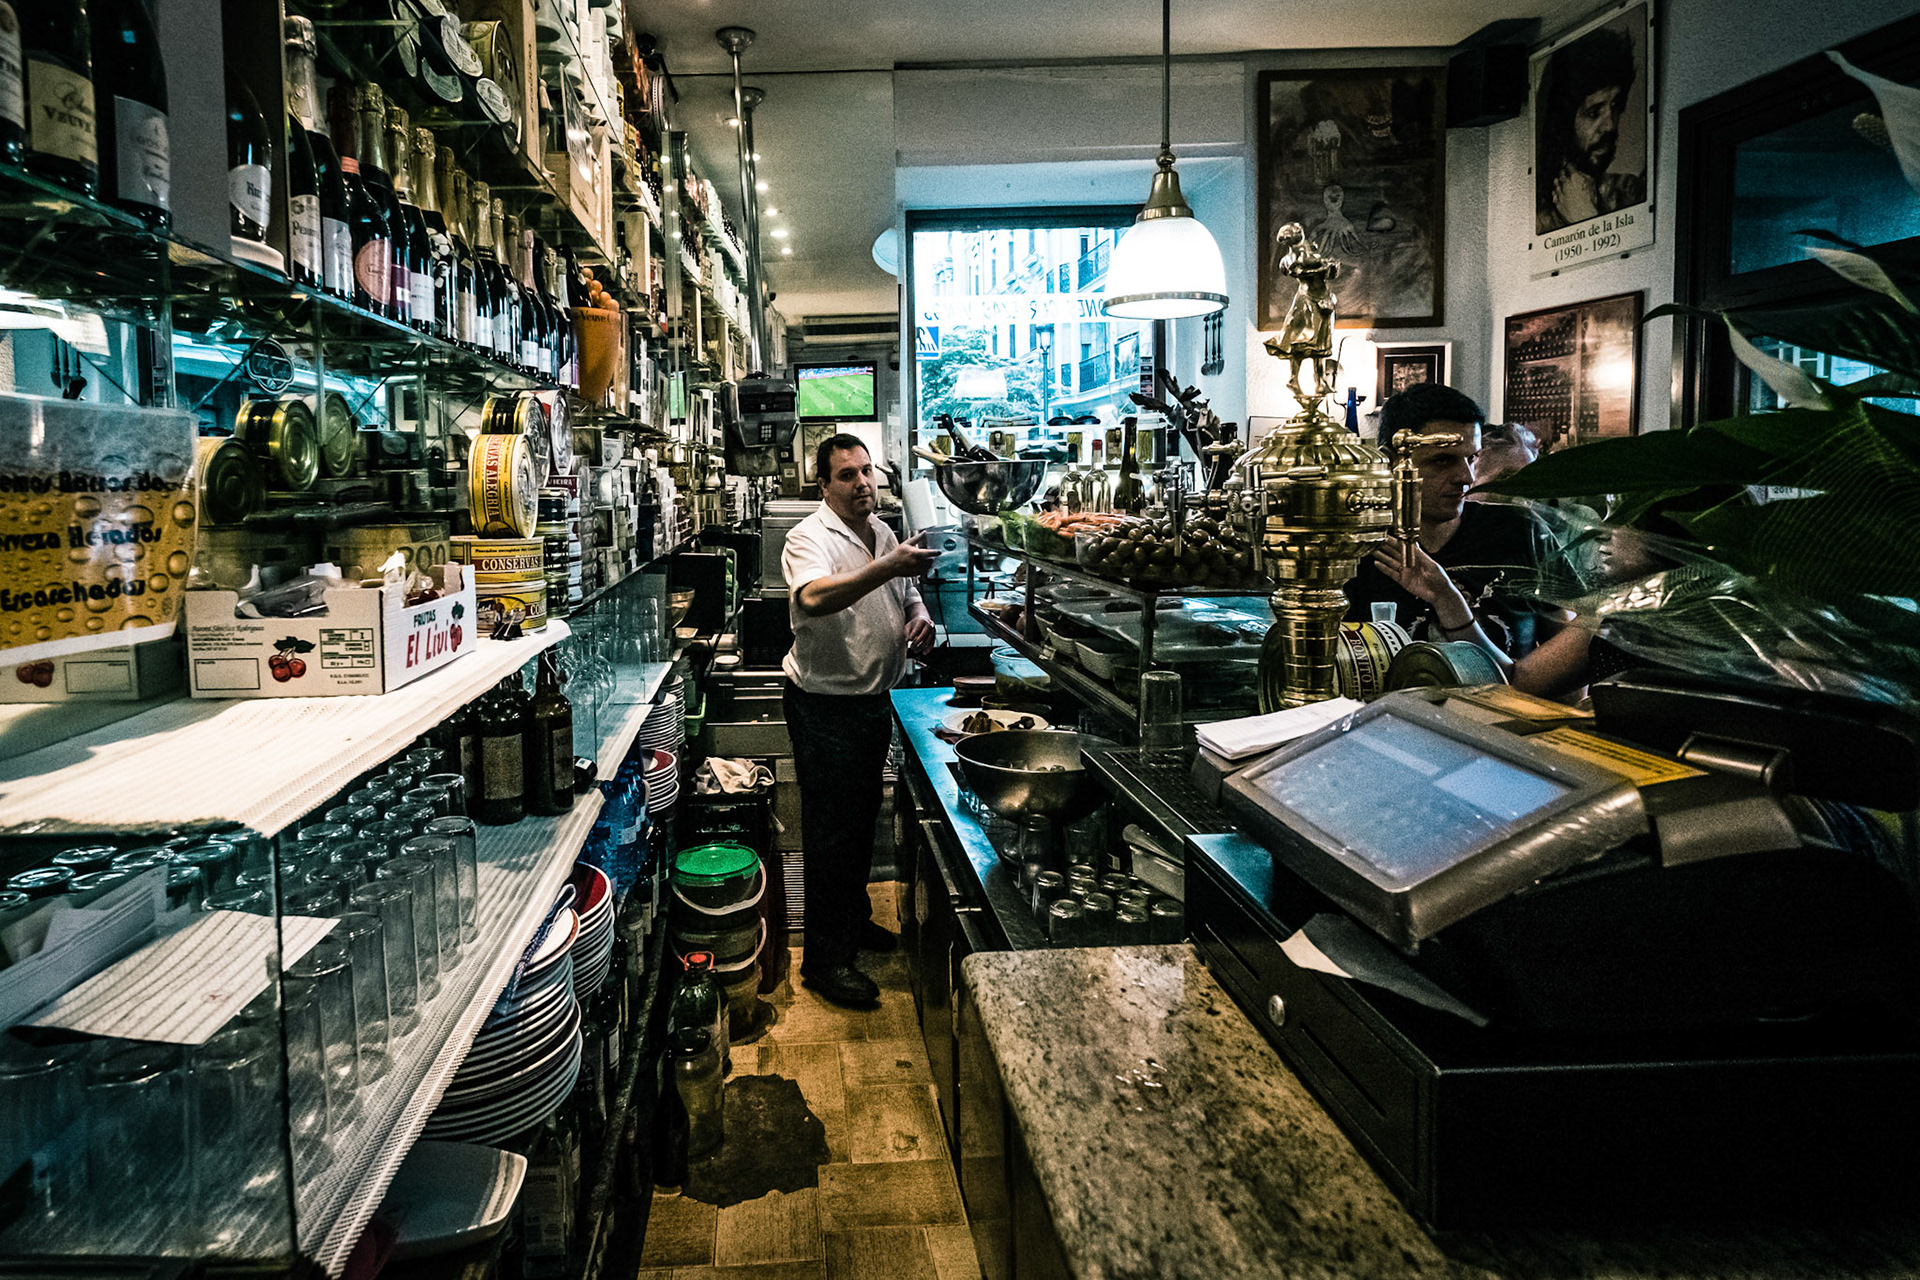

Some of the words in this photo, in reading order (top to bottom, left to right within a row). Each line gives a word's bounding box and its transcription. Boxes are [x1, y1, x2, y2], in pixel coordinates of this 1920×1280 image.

[1544, 228, 1586, 250] Camarón
[1588, 223, 1600, 237] de
[1603, 219, 1613, 232] la
[1615, 213, 1634, 229] Isla
[1555, 245, 1582, 263] (1950
[1593, 233, 1621, 252] 1992)
[486, 469, 500, 516] ALEGRIA
[482, 556, 539, 572] CONSERVAS
[0, 577, 146, 612] Escarchados
[414, 609, 436, 628] FRUTAS
[406, 631, 420, 668] El
[1349, 639, 1373, 683] BONITO
